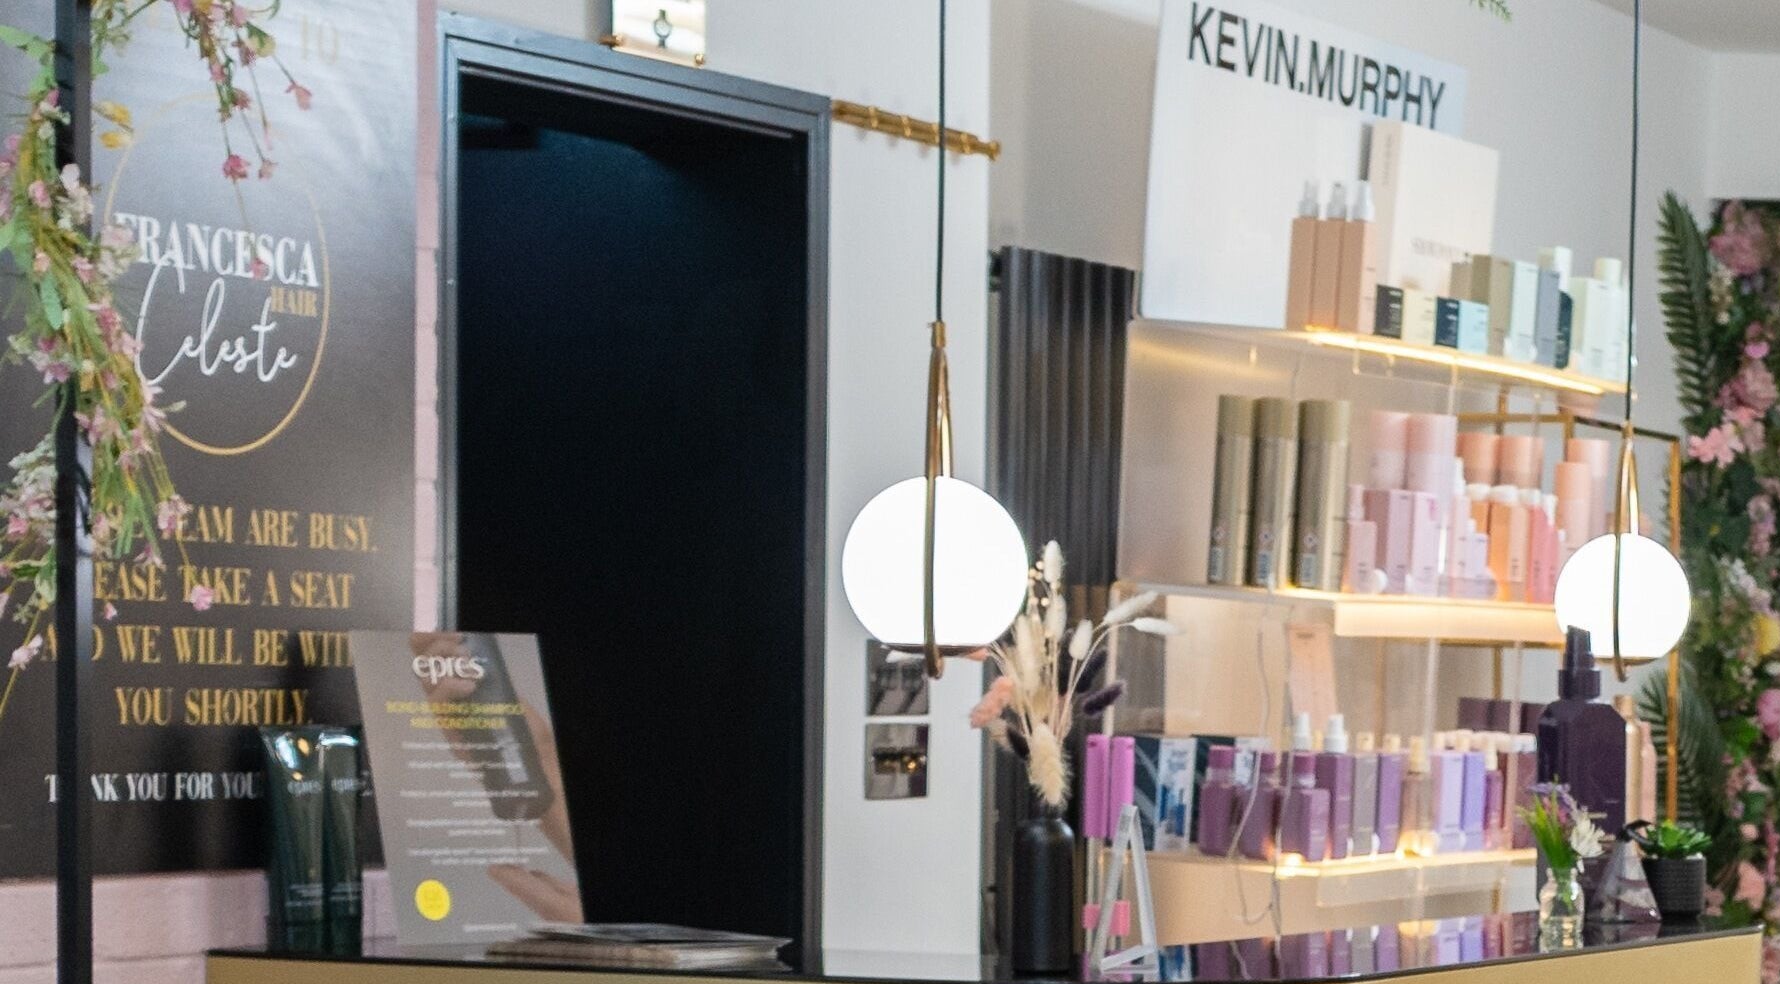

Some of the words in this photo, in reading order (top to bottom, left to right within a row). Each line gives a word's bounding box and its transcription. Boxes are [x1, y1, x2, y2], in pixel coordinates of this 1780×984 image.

[1188, 1, 1446, 129] KEVIN.MURPHY
[135, 252, 297, 387] Celeste
[271, 286, 318, 317] HAIR
[164, 506, 235, 543] EAM
[247, 508, 298, 547] ARE
[94, 561, 167, 602] EASE
[178, 565, 251, 606] TAKE
[261, 570, 280, 606] A
[290, 571, 356, 608] SEAT
[116, 625, 162, 663] WE
[171, 627, 243, 666] WILL
[254, 629, 289, 667] BE
[298, 630, 352, 668] WIT
[412, 654, 485, 685] epres
[114, 686, 173, 726] YOU
[45, 774, 121, 804] TNK
[126, 773, 168, 802] YOU
[174, 773, 214, 800] FOR
